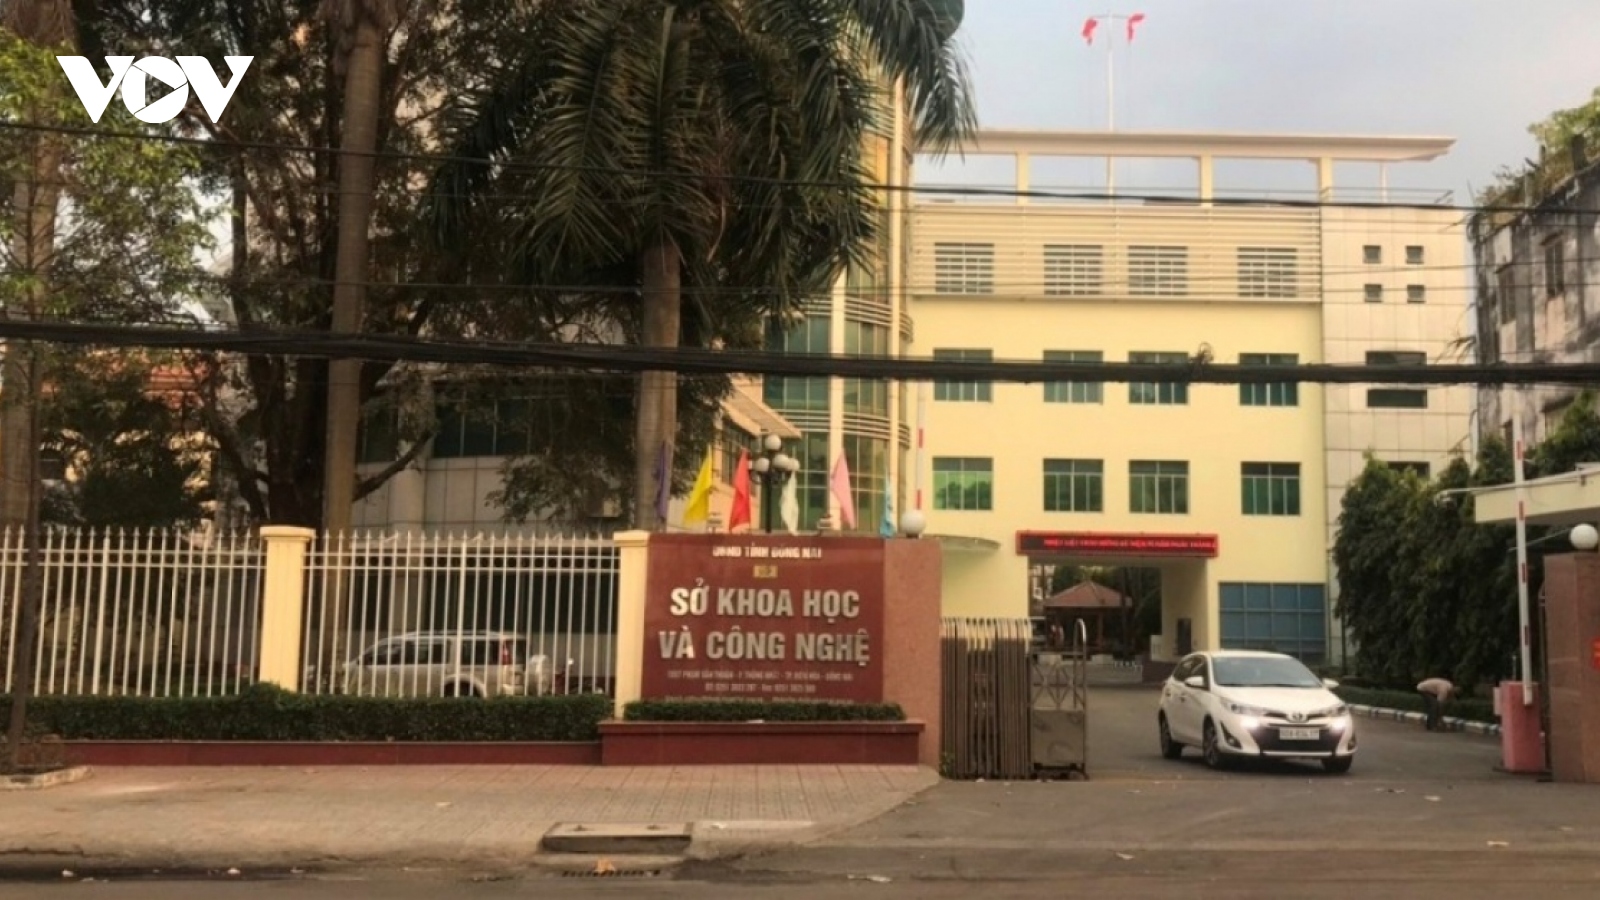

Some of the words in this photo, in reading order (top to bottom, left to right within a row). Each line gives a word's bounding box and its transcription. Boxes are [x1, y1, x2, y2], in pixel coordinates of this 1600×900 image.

[670, 577, 710, 616] SỞ
[717, 588, 794, 617] KHOA
[803, 590, 860, 623] HỌC
[658, 625, 695, 659] VÀ
[706, 625, 786, 660] CÔNG
[795, 628, 871, 666] NGHỆ
